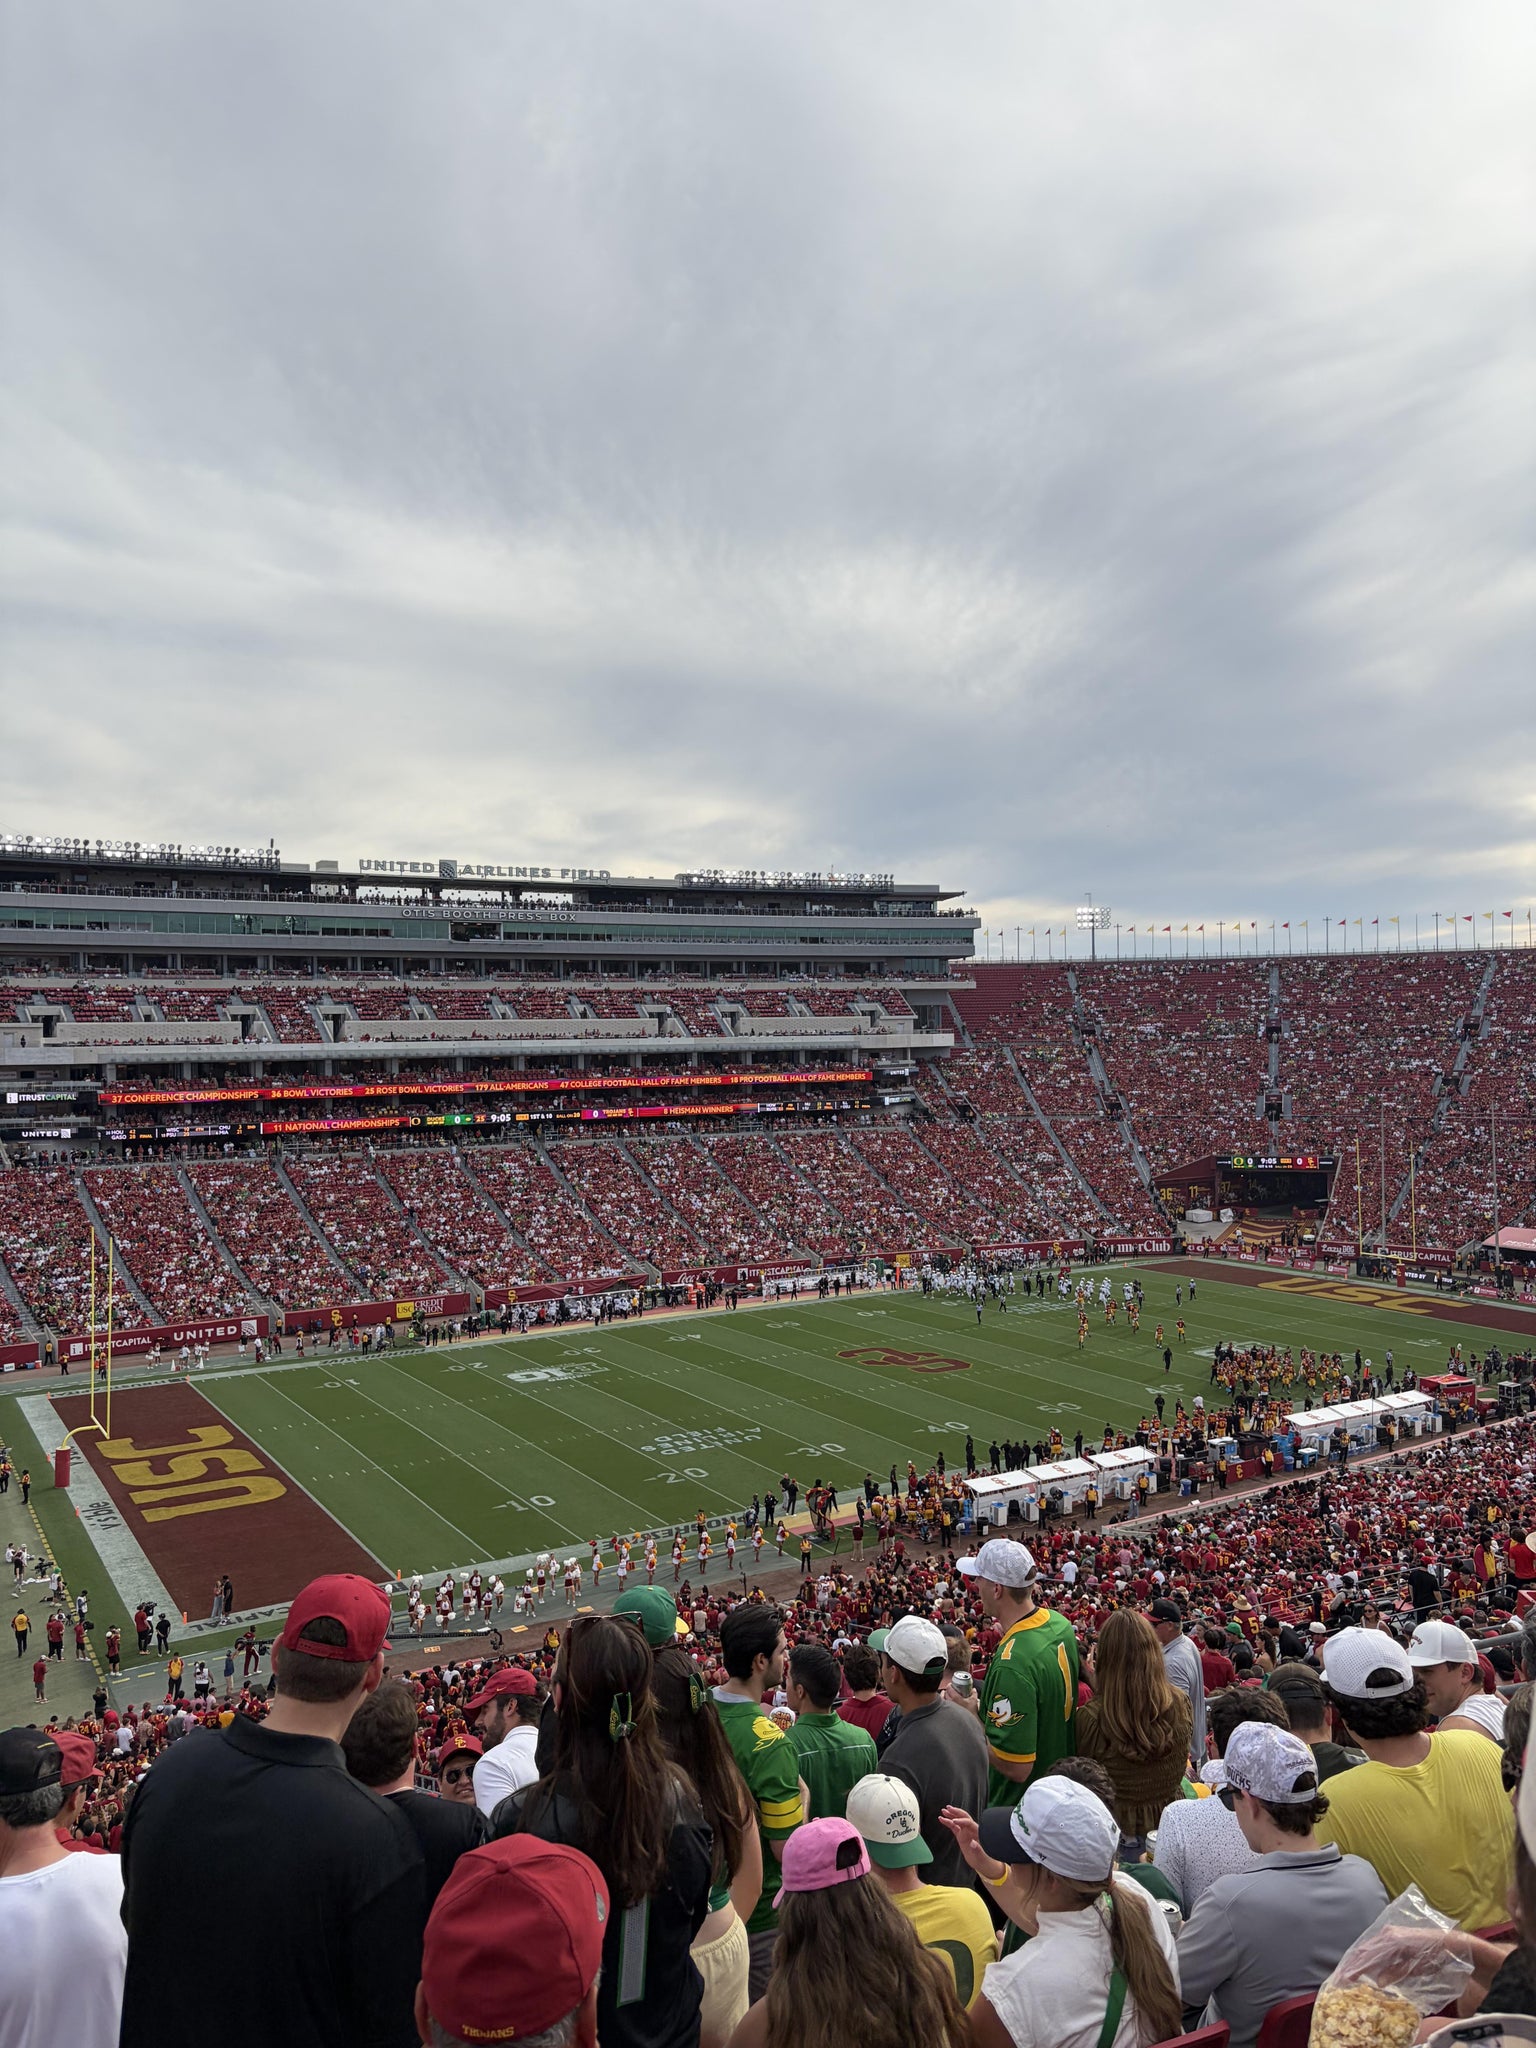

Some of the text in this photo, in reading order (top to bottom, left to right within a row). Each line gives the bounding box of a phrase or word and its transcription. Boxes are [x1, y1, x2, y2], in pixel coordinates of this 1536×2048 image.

[359, 859, 611, 881] UNITED AIRLINES FIELD
[401, 908, 577, 922] OTIS BOOTH PRESS BOX
[112, 1095, 122, 1103] 37
[124, 1093, 184, 1103] CONFERENCE
[186, 1091, 259, 1101] CHAMPIONSHIPS
[271, 1090, 281, 1098] 36
[283, 1089, 308, 1097] BOWL
[309, 1088, 353, 1097] VICTORIES
[365, 1087, 374, 1095] 25
[376, 1086, 397, 1095] ROSE
[398, 1086, 423, 1094] BOWL
[424, 1084, 464, 1093] VICTORIES
[475, 1084, 489, 1092] 179
[490, 1082, 549, 1091] ALL-AMERICANS
[560, 1081, 569, 1089] 47
[570, 1080, 601, 1089] COLLEGE
[603, 1079, 640, 1088] FOOTBALL
[641, 1078, 659, 1087] HALL
[660, 1078, 671, 1086] OF
[671, 1077, 689, 1085] FAME
[690, 1076, 722, 1085] MEMBERS
[739, 1075, 754, 1083] PRO
[755, 1074, 789, 1083] FOOTBALL
[790, 1073, 807, 1082] HALL
[808, 1073, 817, 1081] OF
[818, 1072, 835, 1081] FAME
[836, 1072, 866, 1081] MEMBERS
[19, 1093, 77, 1102] ITRUSTCAPITAL
[454, 1115, 460, 1124] 0
[491, 1114, 511, 1122] 9:05
[593, 1110, 599, 1118] 0
[670, 1106, 699, 1114] HEISMAN
[701, 1105, 733, 1114] WINNERS
[285, 1122, 330, 1131] NATIONAL
[332, 1119, 400, 1129] CHAMPIONSHIPS
[1160, 1187, 1173, 1201] 36
[1188, 1185, 1199, 1198] 11
[1099, 1240, 1170, 1254] SummrClub
[1343, 1245, 1354, 1253] DOG
[1258, 1277, 1473, 1315] USC
[398, 1298, 445, 1314] USC CREDIT
[173, 1325, 238, 1341] UNITED
[928, 1421, 970, 1434] 40
[797, 1443, 847, 1457] 30
[95, 1424, 288, 1523] USC
[656, 1467, 709, 1484] 20
[507, 1494, 557, 1513] 10
[601, 1514, 746, 1551] PROGRESSVE
[1249, 1617, 1259, 1634] 5
[1226, 1765, 1251, 1791] DUCKS
[885, 1809, 916, 1825] OREGON
[462, 2024, 515, 2039] TROJANS
